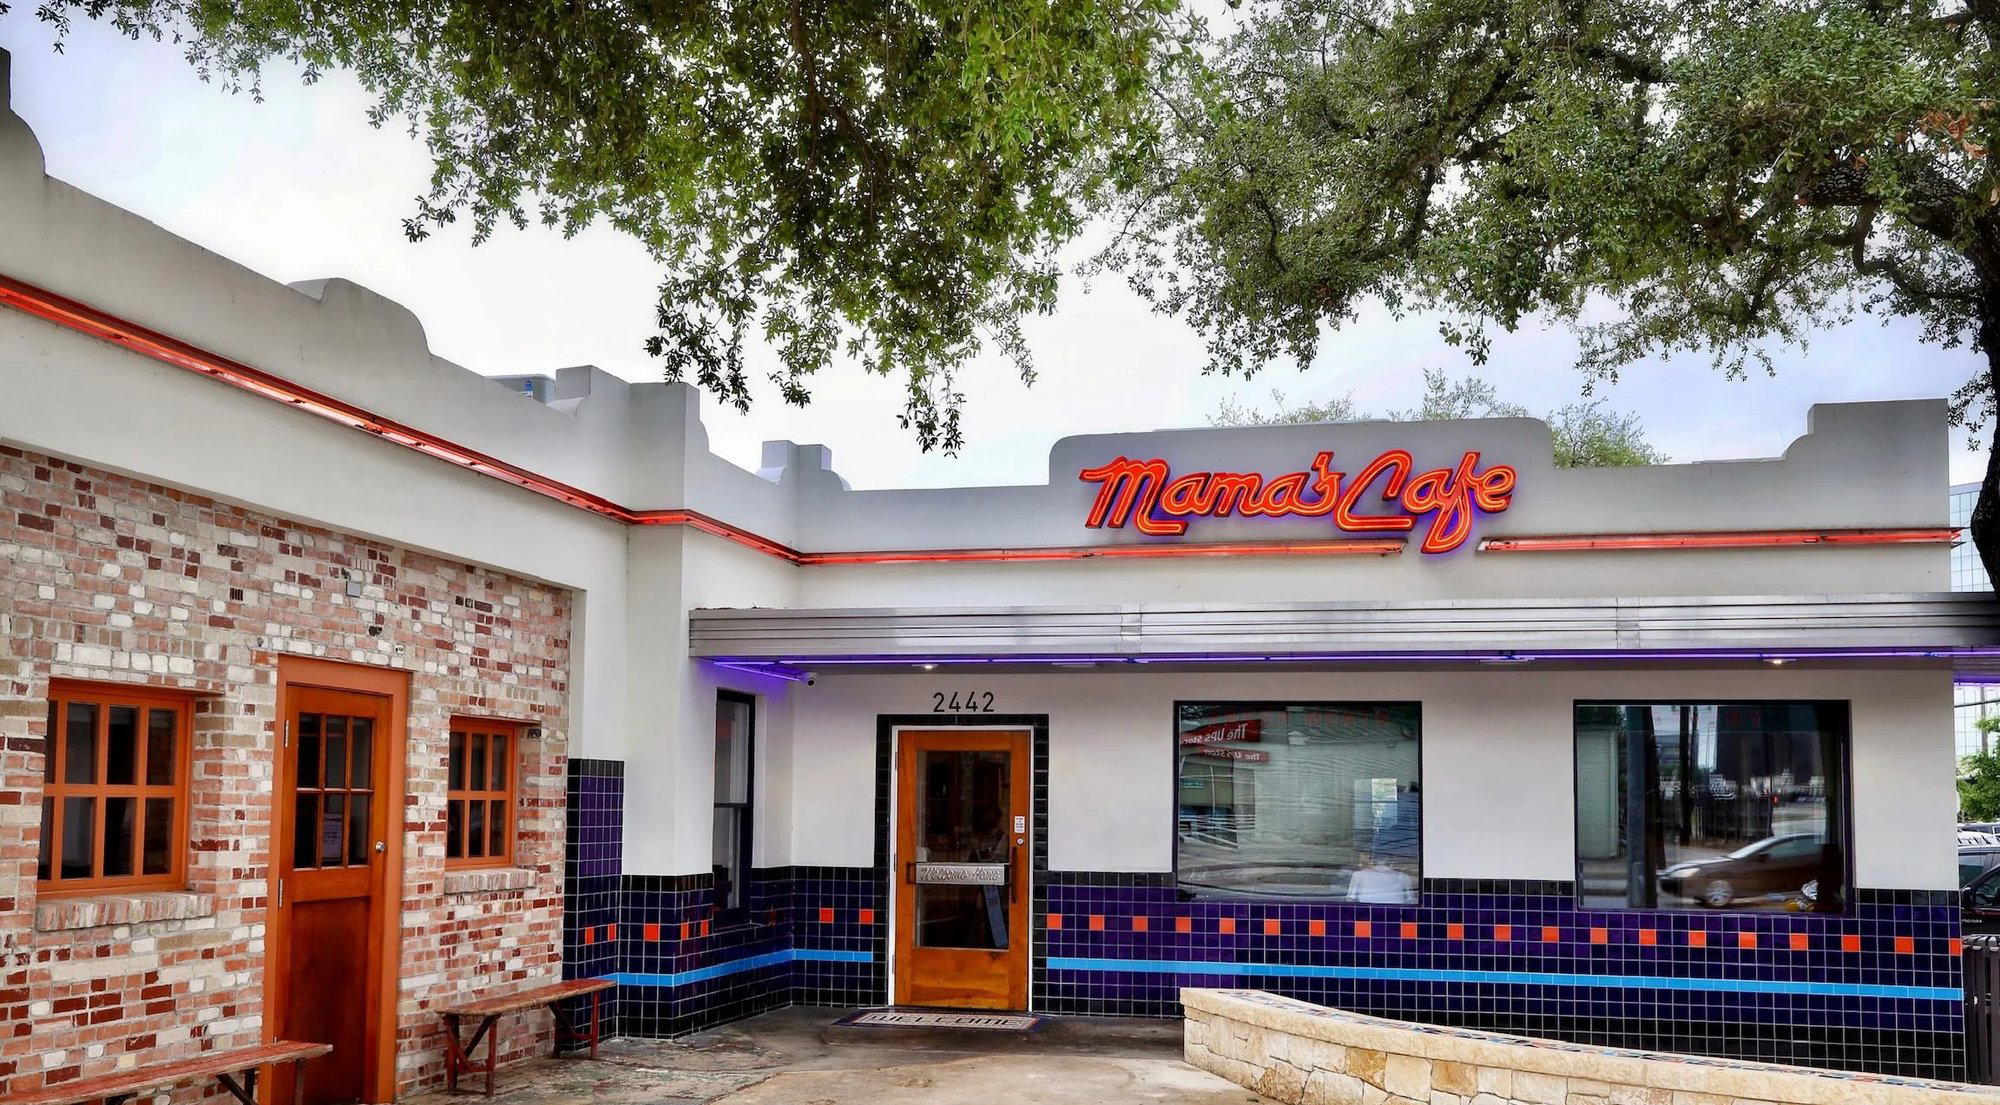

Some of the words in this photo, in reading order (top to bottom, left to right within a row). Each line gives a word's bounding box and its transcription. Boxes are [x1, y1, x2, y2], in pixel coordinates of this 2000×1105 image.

[1079, 452, 1347, 536] Mama's
[1335, 449, 1517, 554] Cafe
[933, 691, 995, 712] 2442
